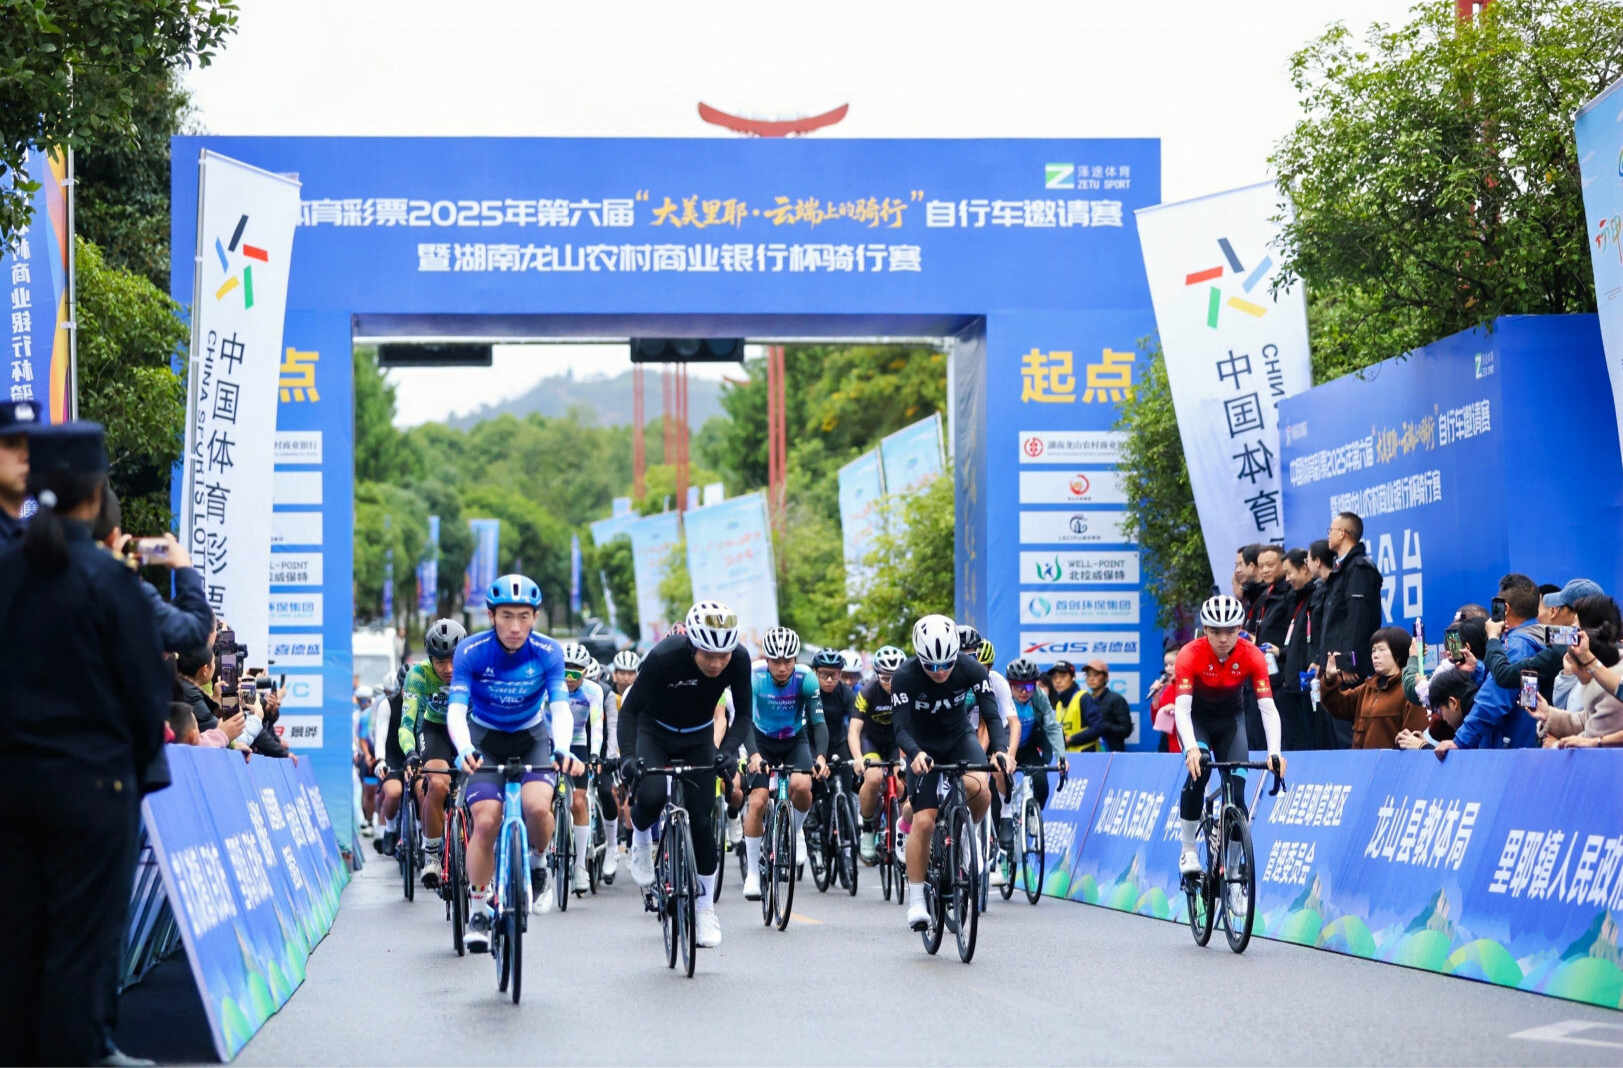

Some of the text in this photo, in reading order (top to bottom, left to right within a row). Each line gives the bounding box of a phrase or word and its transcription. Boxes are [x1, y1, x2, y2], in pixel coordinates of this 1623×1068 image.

[1104, 179, 1131, 190] SPORT
[417, 244, 922, 273] 暨湖南龙山农村商业银行杯骑行赛
[199, 330, 217, 402] CHINA
[1020, 347, 1136, 404] 起点
[1364, 794, 1482, 871] 龙山县教体局
